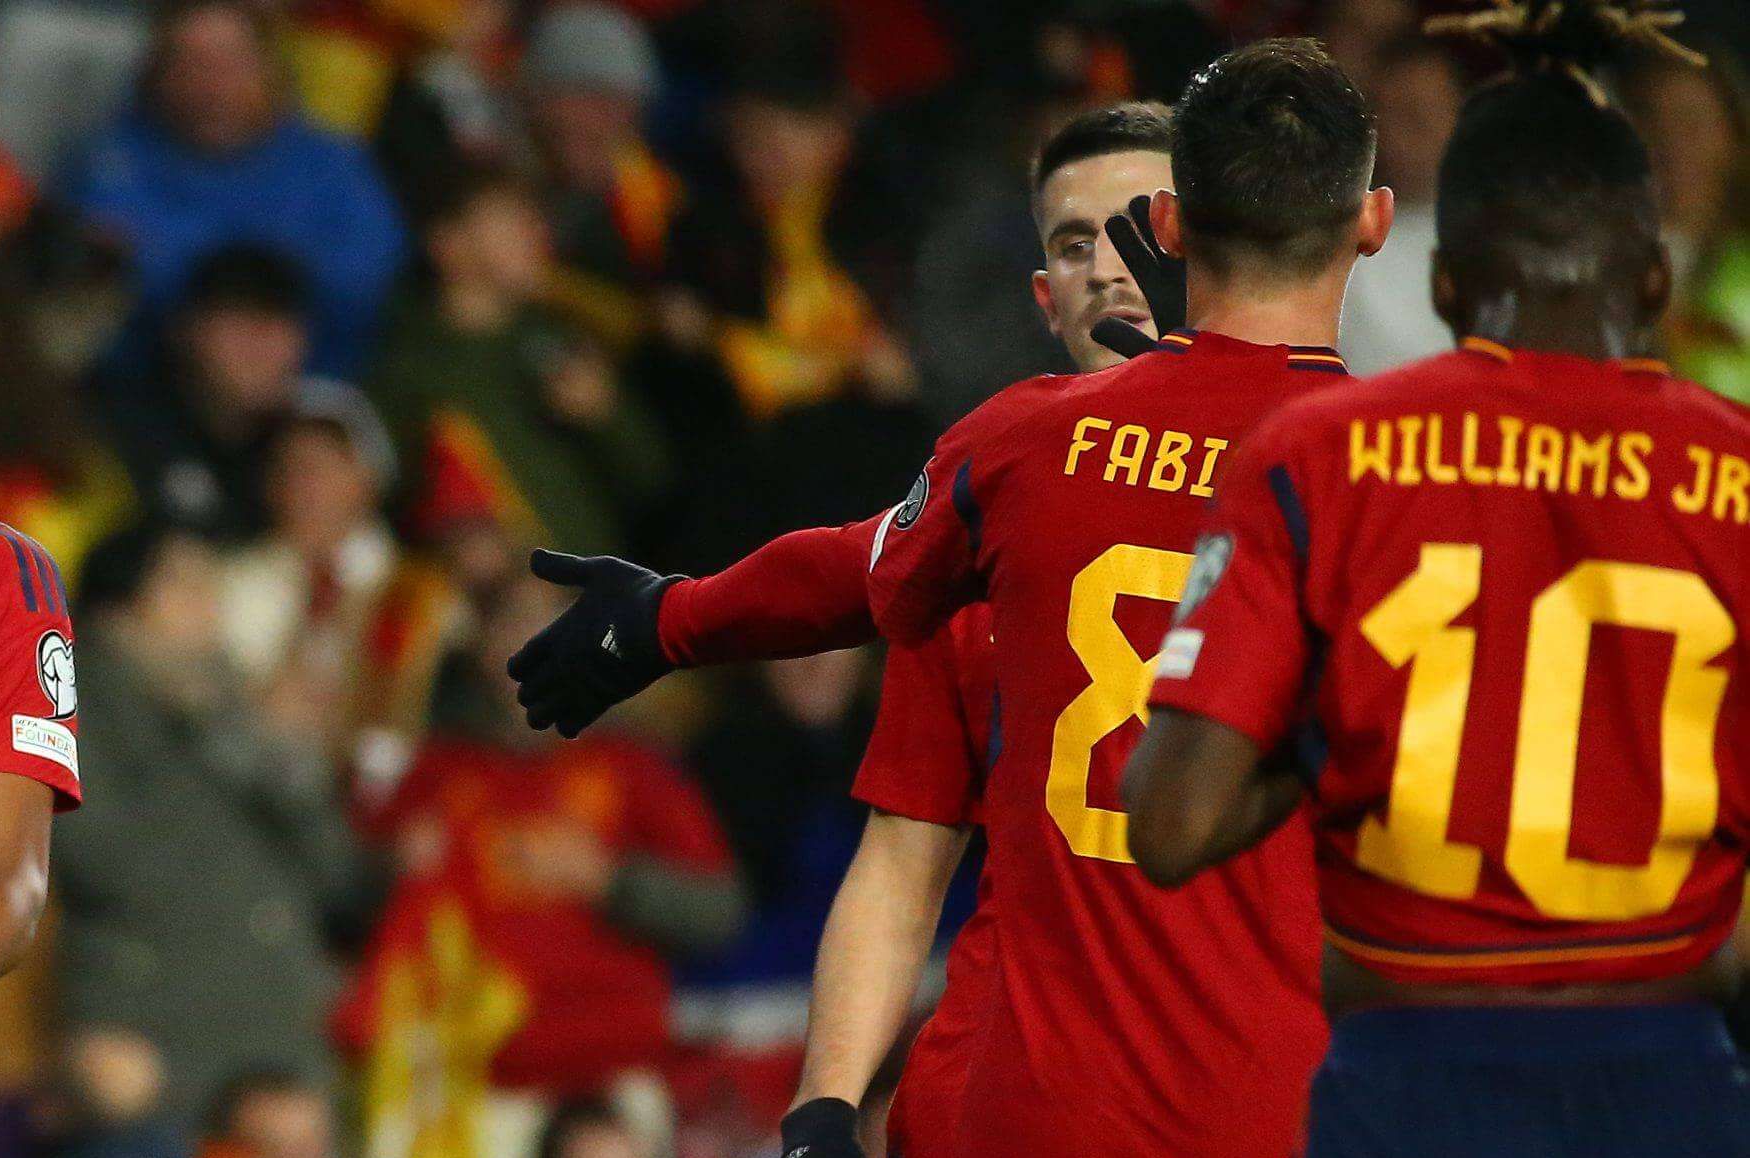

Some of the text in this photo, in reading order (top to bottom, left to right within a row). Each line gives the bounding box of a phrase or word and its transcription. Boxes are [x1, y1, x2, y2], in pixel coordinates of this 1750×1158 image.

[1064, 416, 1229, 498] FABI
[1349, 411, 1654, 502] WILLIAMS
[15, 726, 71, 752] FOUNDA
[1046, 543, 1196, 864] 8
[1354, 542, 1738, 922] 10
